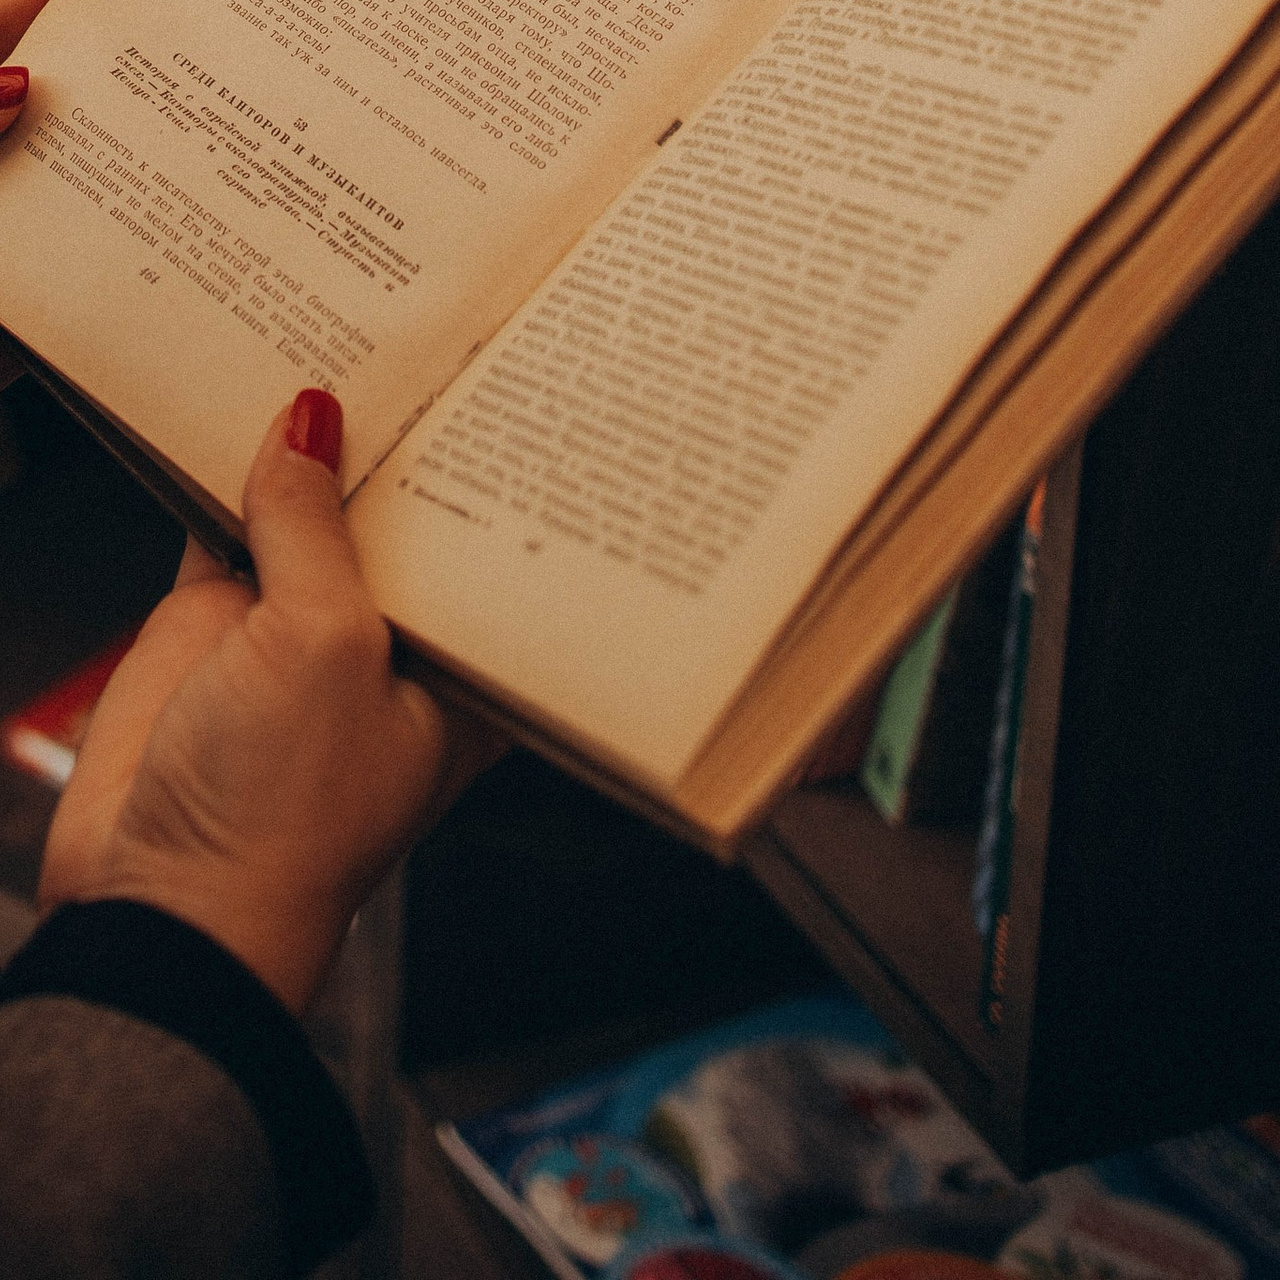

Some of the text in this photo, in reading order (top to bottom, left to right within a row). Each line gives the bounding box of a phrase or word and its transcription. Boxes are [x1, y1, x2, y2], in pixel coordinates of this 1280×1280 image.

[332, 15, 397, 68] «писатель»,
[402, 68, 476, 120] растягивая
[402, 3, 450, 41] учителя
[454, 41, 521, 90] присвоили
[526, 88, 582, 130] Шолому
[576, 41, 626, 79] просить
[584, 26, 638, 64] несчаст-
[604, 20, 650, 52] исклю-
[636, 2, 674, 30] когда
[124, 46, 327, 207] История еврейской книжкой,
[226, 0, 425, 147] звание осталось
[293, 117, 308, 131] 53
[380, 29, 498, 115] имени, называли
[391, 19, 428, 50] доске,
[479, 80, 554, 135] обращались
[514, 41, 601, 106] степендиатом,
[547, 84, 591, 116] исклю-
[35, 126, 183, 243] телем, пишущим мелом
[44, 111, 251, 274] проявлял ранних мечтой
[71, 107, 271, 268] Склонность писательству герой
[157, 105, 190, 132] Гешл
[263, 188, 301, 222] орава.
[317, 230, 375, 278] Страсть
[158, 89, 323, 222] Канторы «коловратурой».
[172, 52, 404, 230] СРЕДИ КАНТОРОВ И МУЗЫКАНТОВ
[216, 169, 267, 208] скрипке
[48, 159, 228, 303] писателем, автором настоящей
[139, 267, 160, 284] 464
